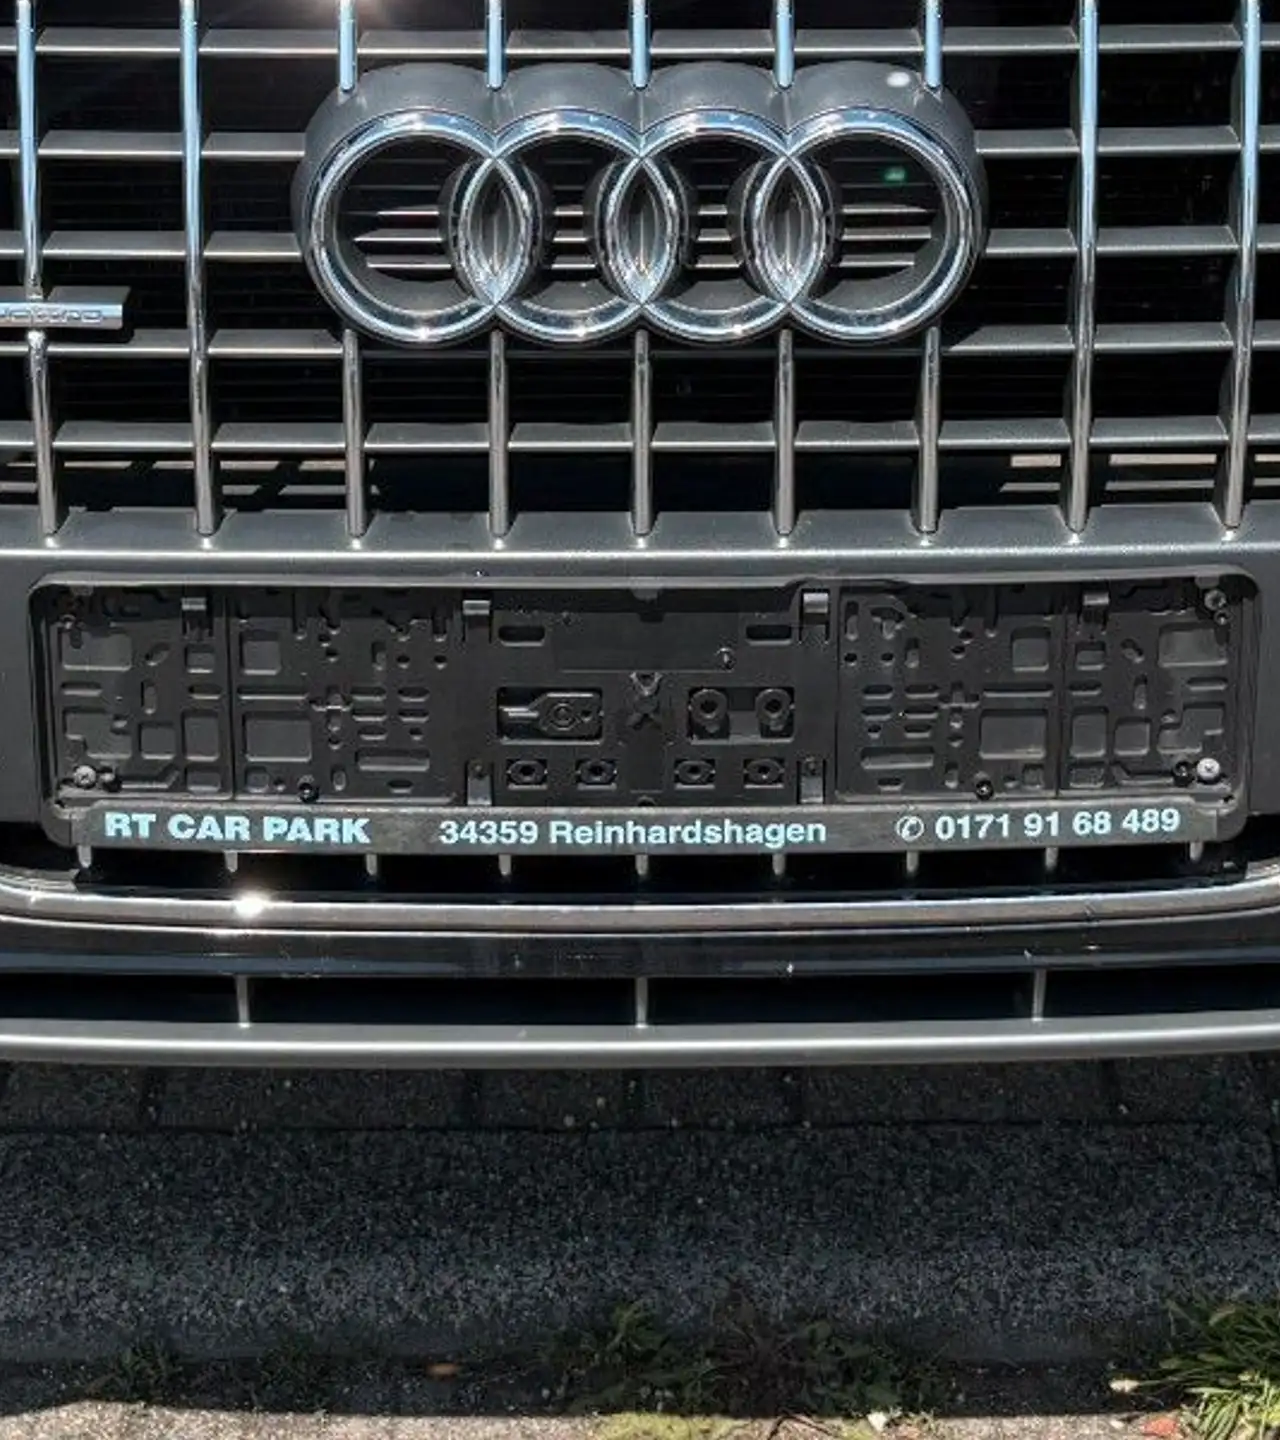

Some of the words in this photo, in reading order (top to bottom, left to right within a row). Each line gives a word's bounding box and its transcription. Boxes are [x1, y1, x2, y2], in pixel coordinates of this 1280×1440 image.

[104, 811, 156, 838] RT
[168, 813, 251, 842] CAR
[262, 815, 372, 844] PARK
[438, 820, 538, 845] 34359
[548, 819, 827, 849] Reinhardshagen
[934, 813, 1010, 840] 0171
[1023, 811, 1060, 837] 91
[1072, 809, 1112, 835] 68
[1121, 807, 1181, 834] 489
